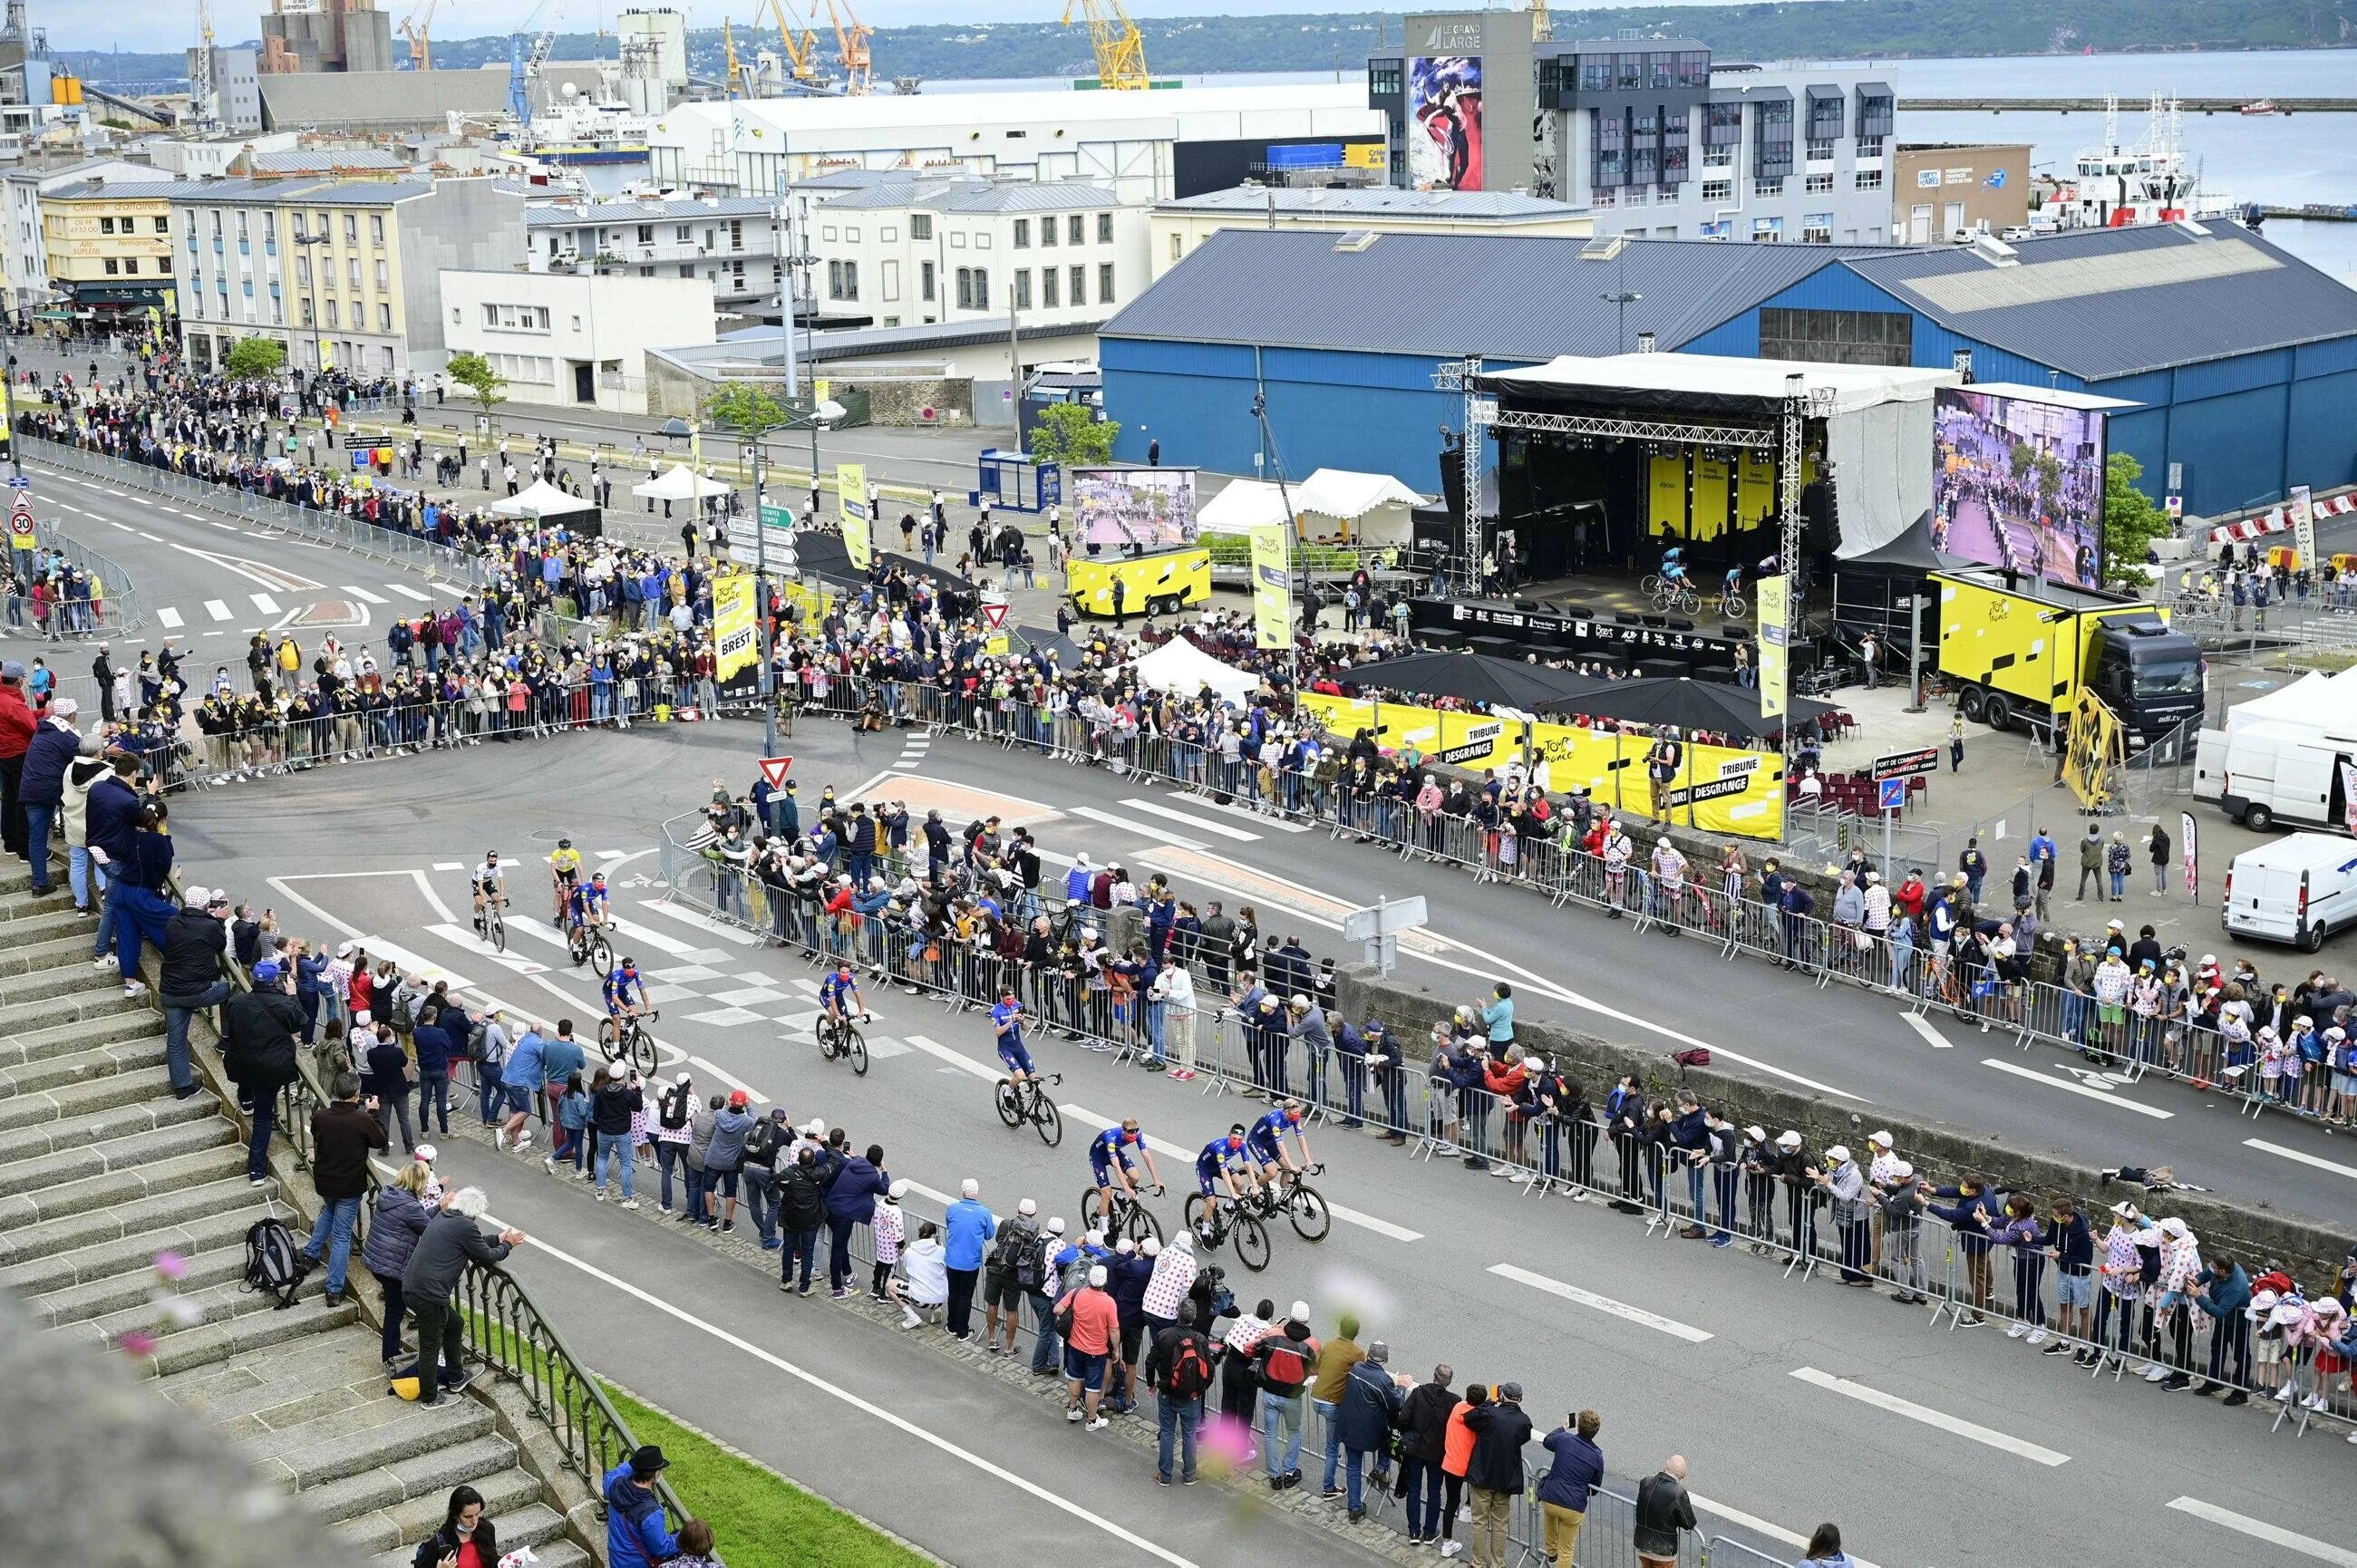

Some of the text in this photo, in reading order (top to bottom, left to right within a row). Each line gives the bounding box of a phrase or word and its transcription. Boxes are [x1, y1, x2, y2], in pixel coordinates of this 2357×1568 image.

[1443, 24, 1480, 34] LE GRAND
[1443, 35, 1480, 49] LARGE
[73, 202, 106, 211] Centre
[115, 202, 159, 211] d'affaires
[15, 518, 30, 529] 30
[722, 631, 752, 655] BREST
[1469, 723, 1500, 740] TRIBUNE
[1445, 741, 1493, 763] DESGRANGE
[1544, 736, 1572, 753] TOUR
[1722, 759, 1758, 776] TRIBUNE
[1877, 760, 1889, 769] PORT
[1897, 754, 1923, 765] COMMERCE
[1695, 777, 1747, 799] DESGRANGE
